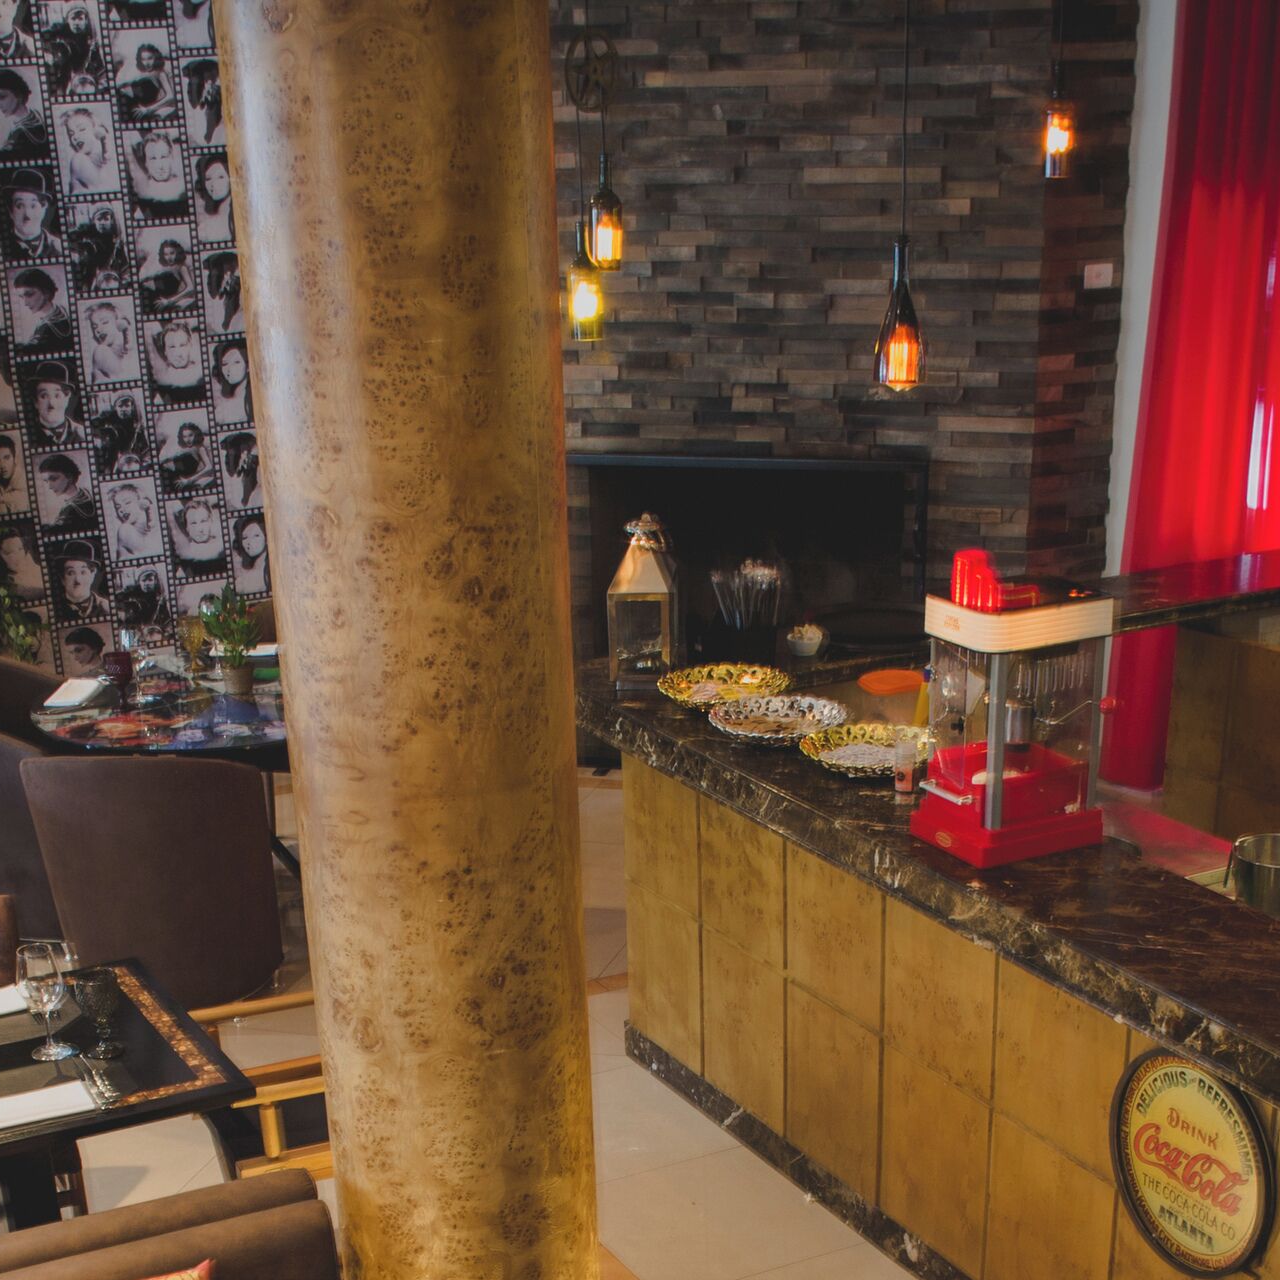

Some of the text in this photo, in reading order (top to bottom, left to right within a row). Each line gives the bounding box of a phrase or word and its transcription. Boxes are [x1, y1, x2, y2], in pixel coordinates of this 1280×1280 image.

[1135, 1070, 1188, 1118] DELICIOUS
[1167, 1107, 1218, 1150] DRINK
[1133, 1122, 1249, 1216] Coca-Cola
[1142, 1172, 1161, 1195] THE
[1158, 1204, 1214, 1253] ATLANTA
